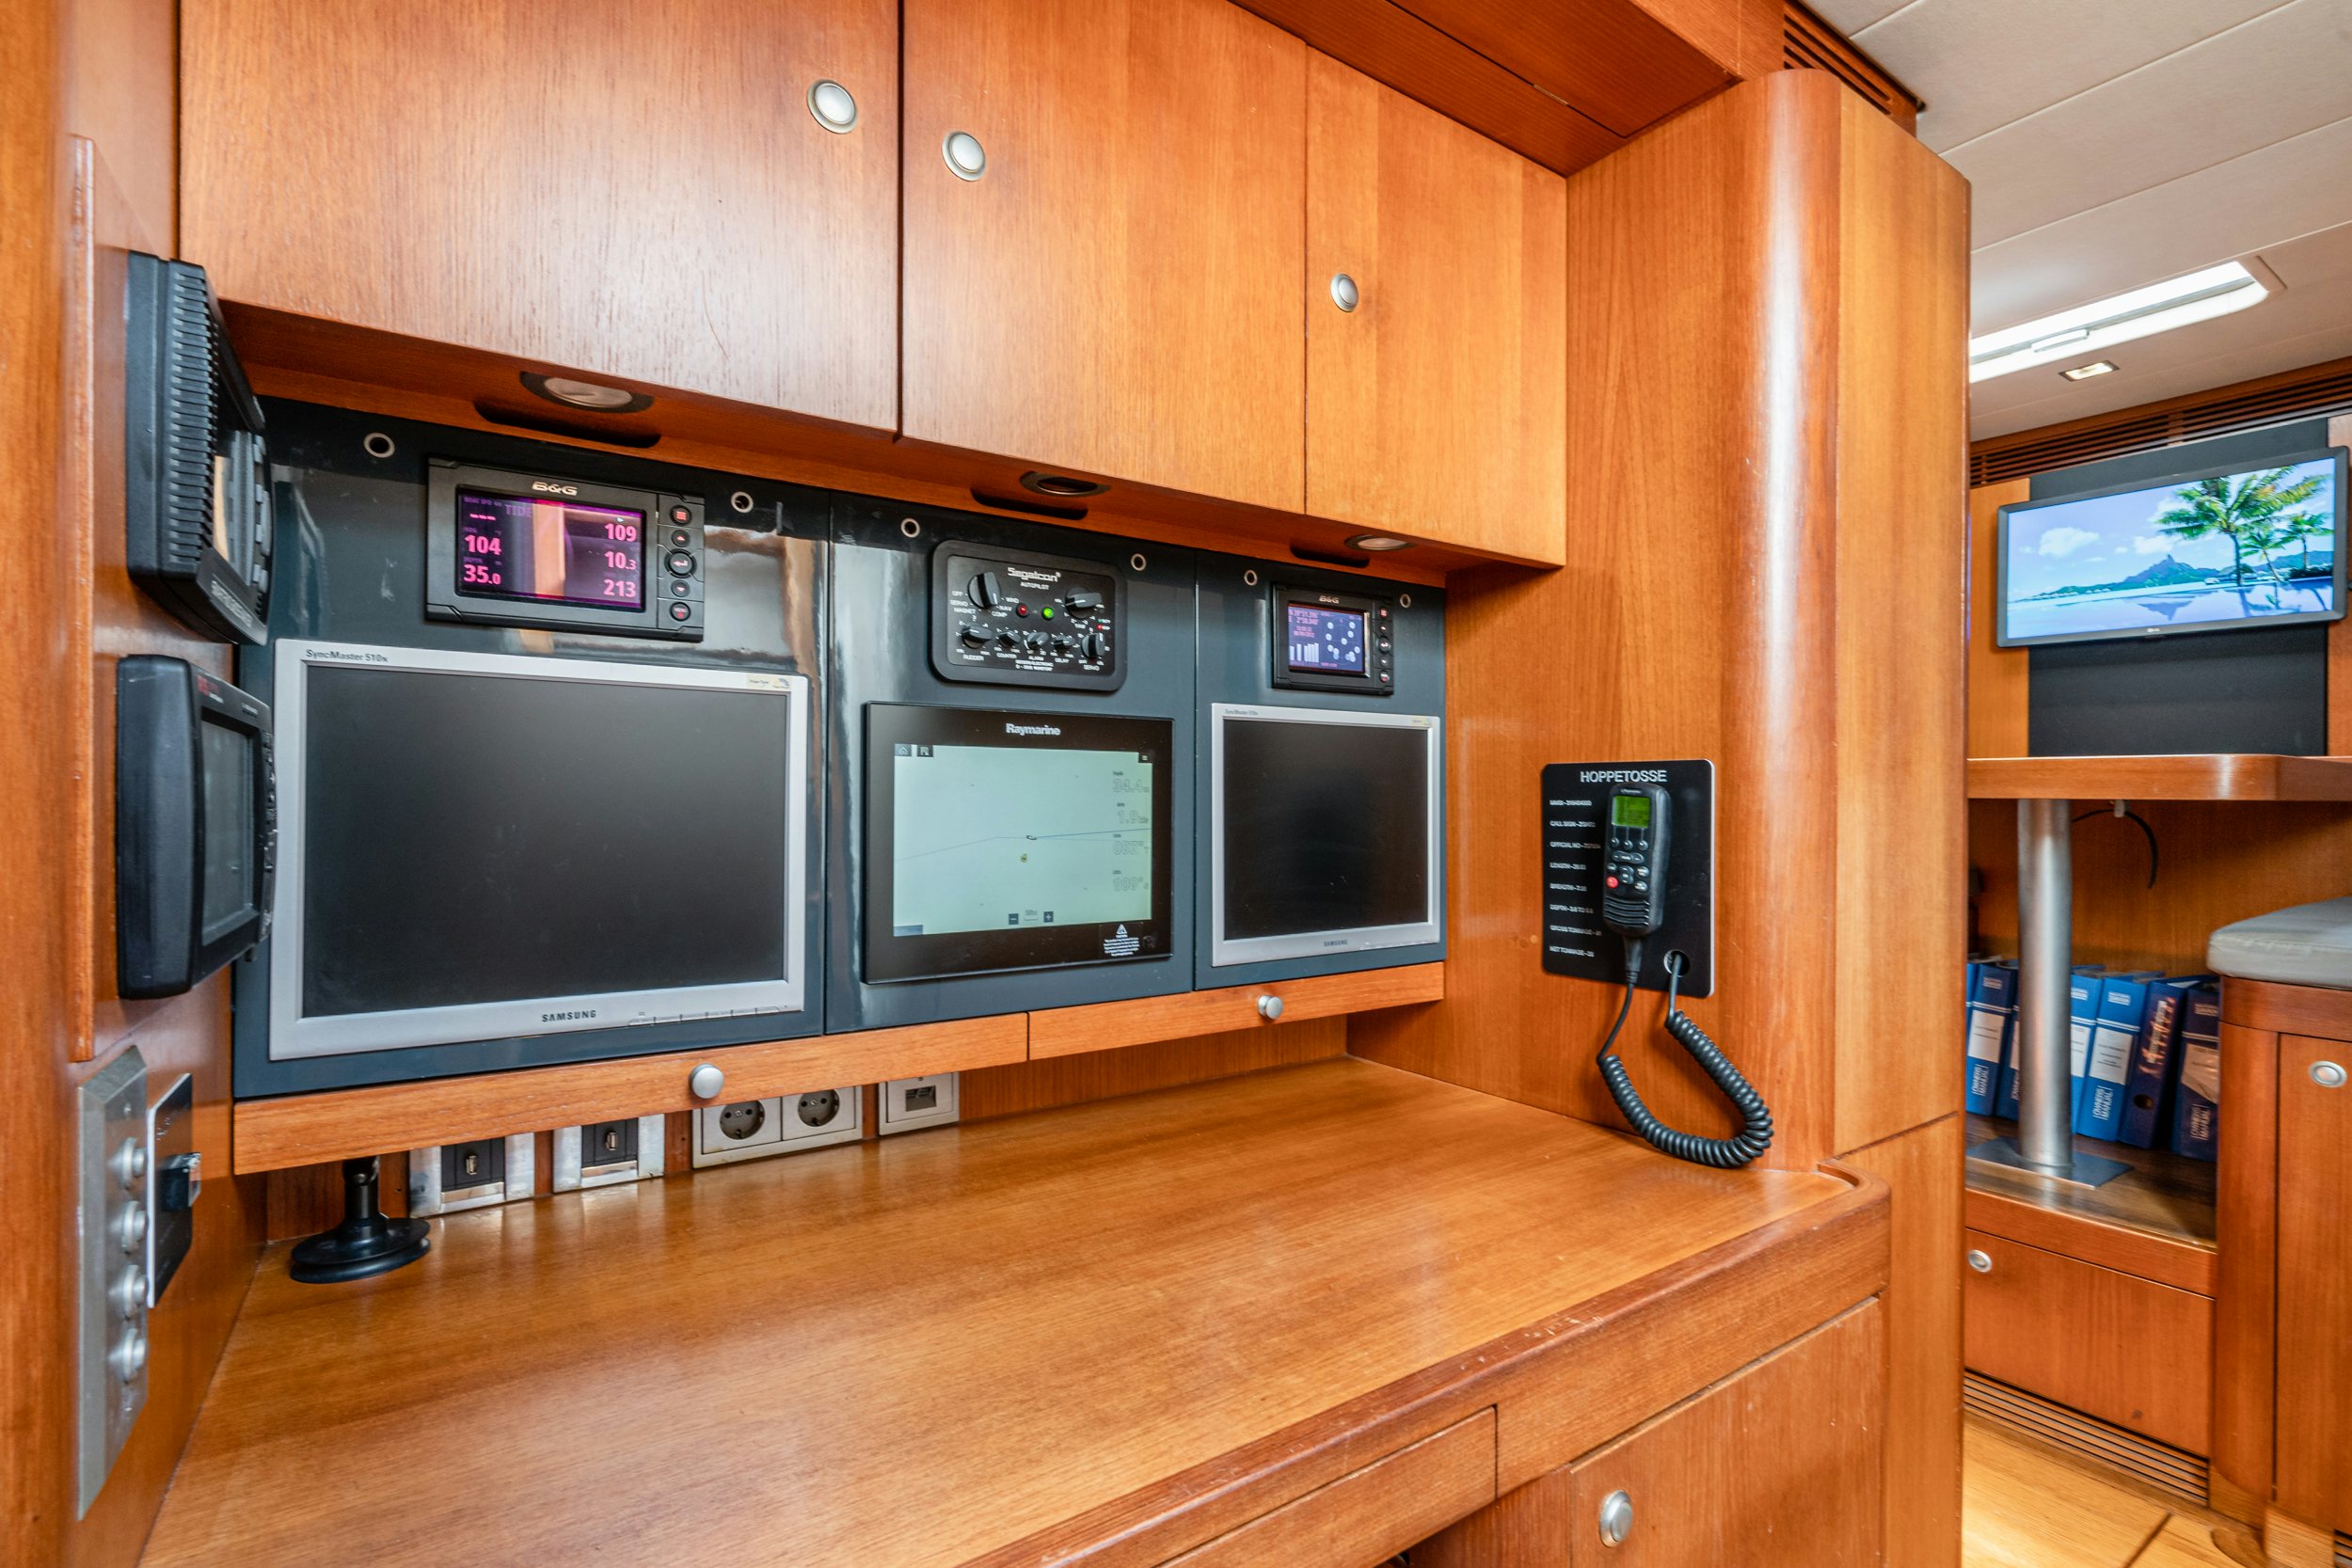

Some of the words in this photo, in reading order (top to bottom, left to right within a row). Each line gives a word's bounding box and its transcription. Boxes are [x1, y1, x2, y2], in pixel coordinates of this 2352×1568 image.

[532, 481, 578, 497] B&G
[504, 504, 532, 517] TIDE
[605, 523, 637, 542] 109
[465, 534, 501, 555] 104
[604, 551, 637, 570] 10.3
[464, 563, 501, 585] 35.0
[603, 578, 636, 598] 213
[306, 649, 363, 660] SyncMaster
[1006, 723, 1061, 736] Raymarine
[1581, 769, 1667, 783] HOPPETOSSE
[542, 1009, 596, 1022] SAMSUNG
